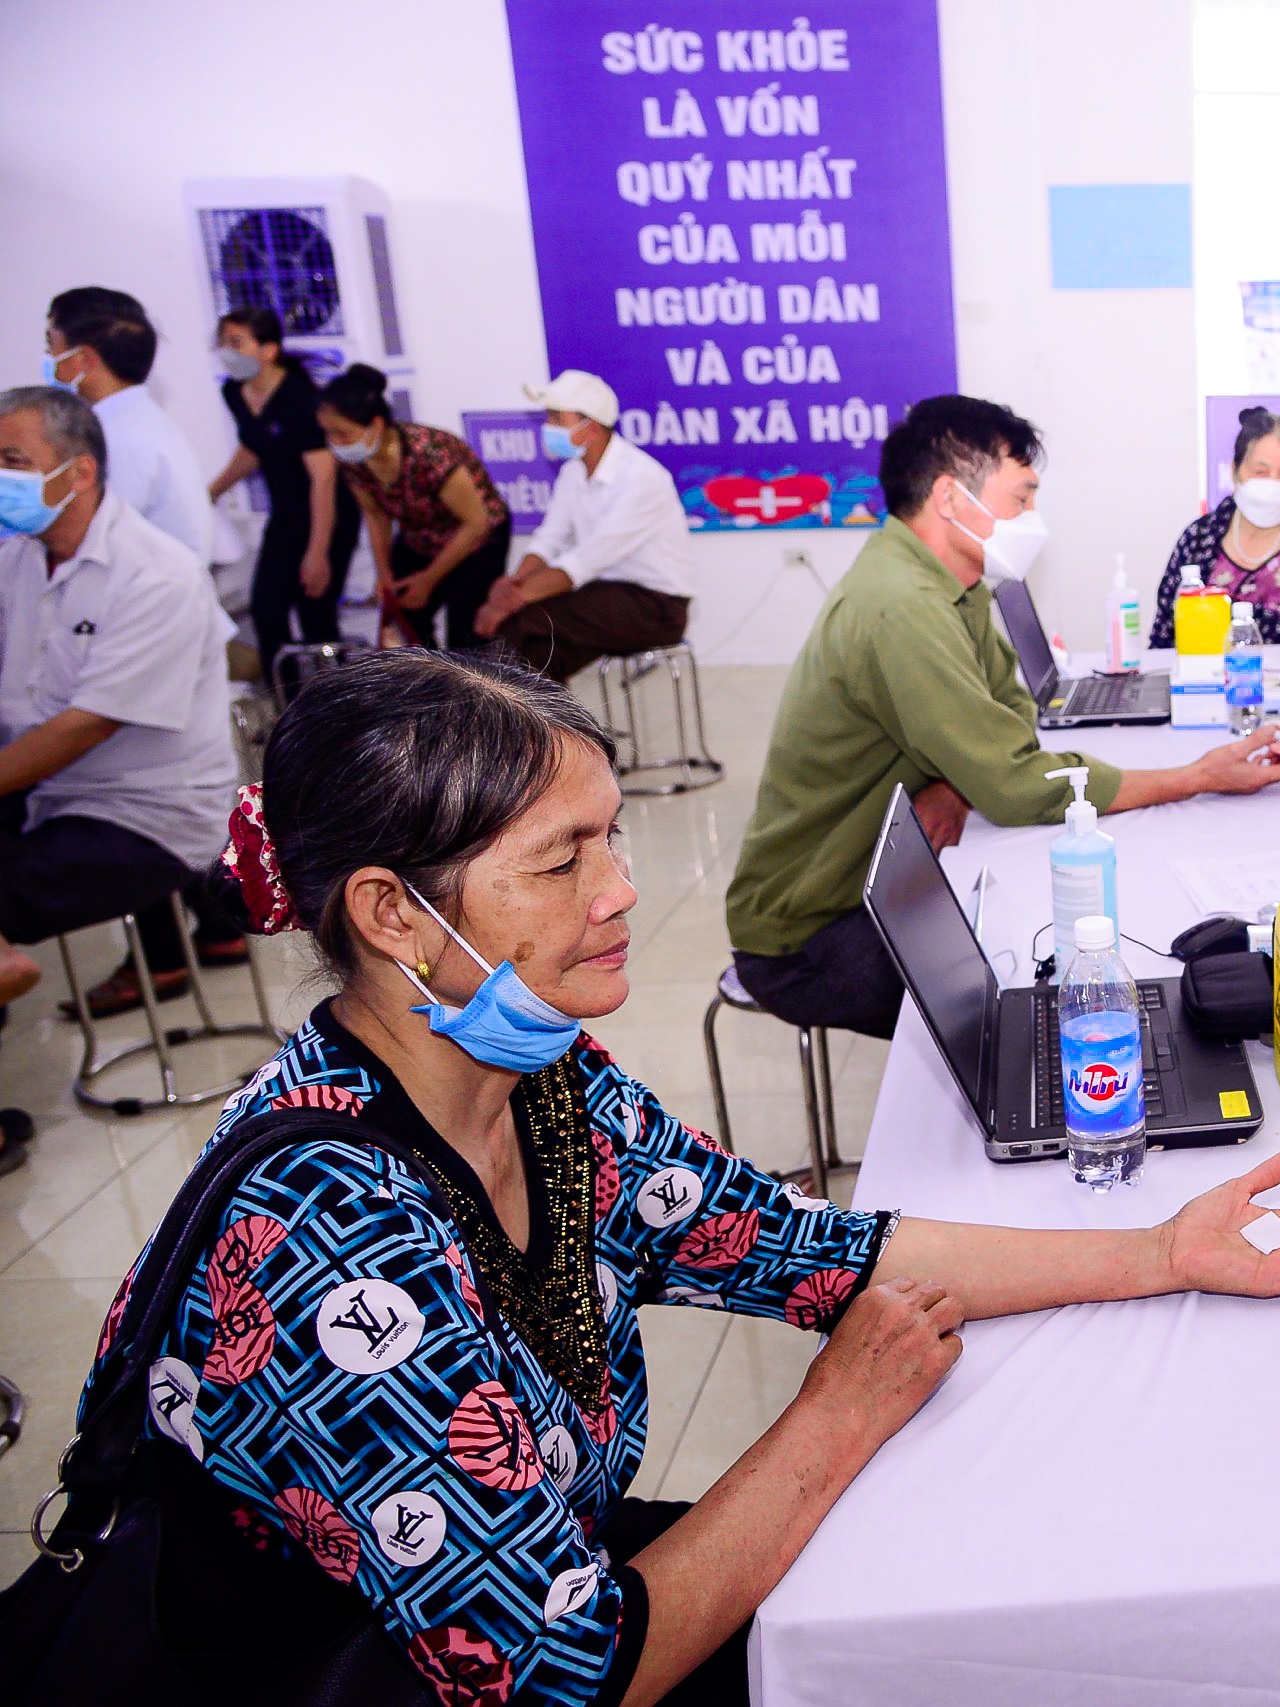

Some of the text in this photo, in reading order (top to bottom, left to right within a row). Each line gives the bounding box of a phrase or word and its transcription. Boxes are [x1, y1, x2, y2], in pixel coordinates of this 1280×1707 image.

[602, 17, 850, 75] SỨC KHỎE
[643, 82, 820, 139] LÀ VỐN
[616, 146, 856, 206] QUÝ NHẤT
[638, 209, 847, 265] CỦA MỖI
[615, 276, 880, 326] NGƯỜI DÂN
[666, 334, 841, 386] VÀ CỦA
[480, 430, 537, 462] KHU
[615, 397, 888, 449] OÀN XÃ HỘI
[371, 1341, 391, 1360] Louis
